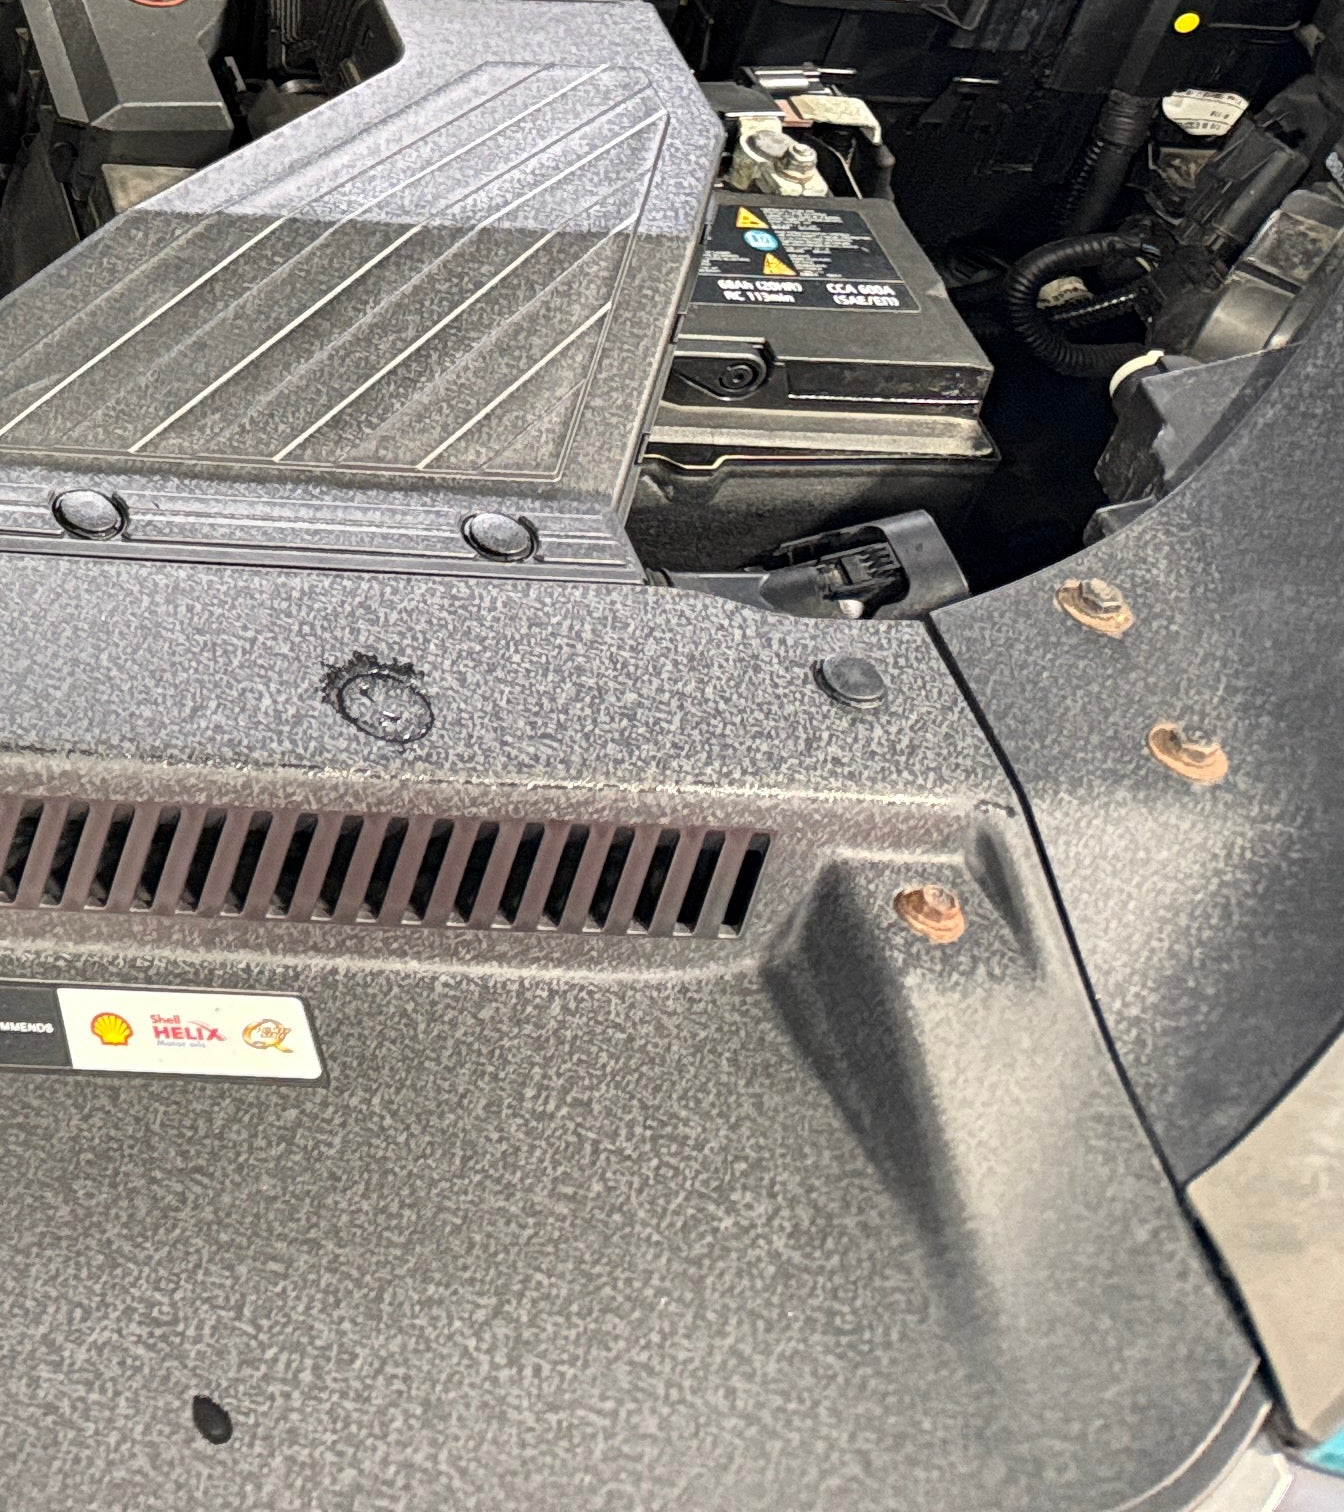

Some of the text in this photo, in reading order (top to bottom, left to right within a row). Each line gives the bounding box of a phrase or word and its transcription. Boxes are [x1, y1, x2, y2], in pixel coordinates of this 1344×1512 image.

[826, 283, 896, 295] CCA 600A
[150, 1014, 181, 1025] Shell
[152, 1025, 226, 1042] HELIX
